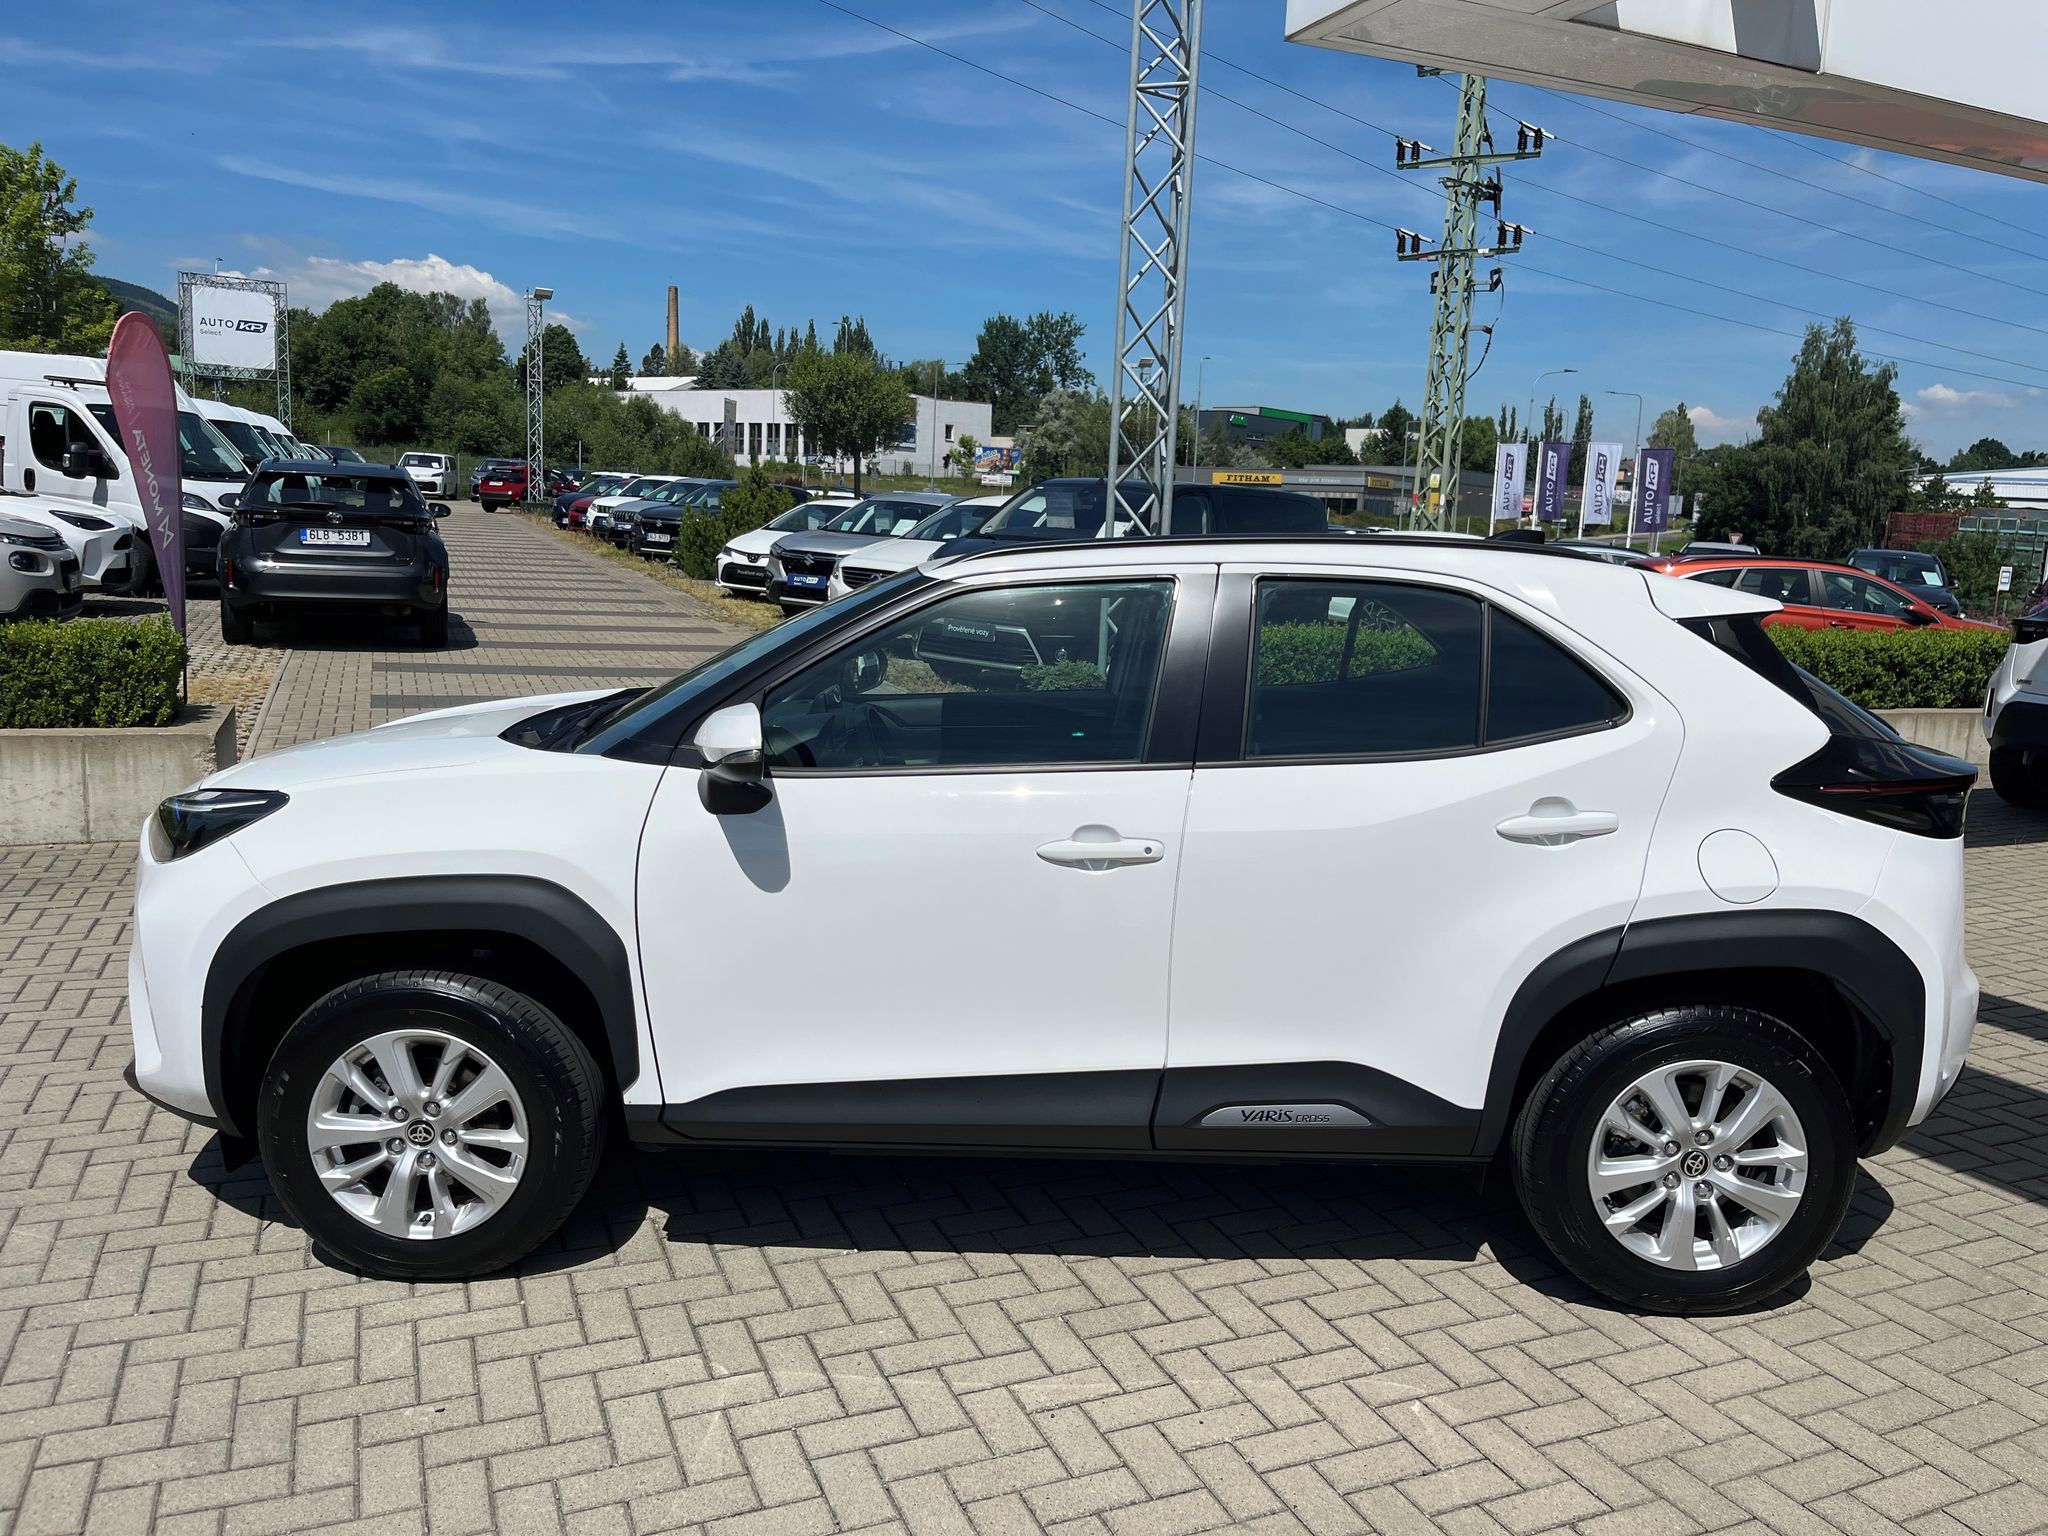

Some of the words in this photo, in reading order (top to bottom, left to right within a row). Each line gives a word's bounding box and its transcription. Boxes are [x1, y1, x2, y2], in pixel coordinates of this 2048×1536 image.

[199, 317, 234, 329] AUTO
[1227, 474, 1270, 483] FITHAM
[1502, 482, 1510, 511] AUTO
[1545, 481, 1554, 512] AUTO
[1594, 485, 1604, 515] AUTO
[1643, 490, 1655, 525] AUTO
[309, 529, 329, 540] 6L8
[338, 530, 364, 541] 5381
[976, 629, 990, 638] vozy
[1296, 1114, 1330, 1123] CROSS
